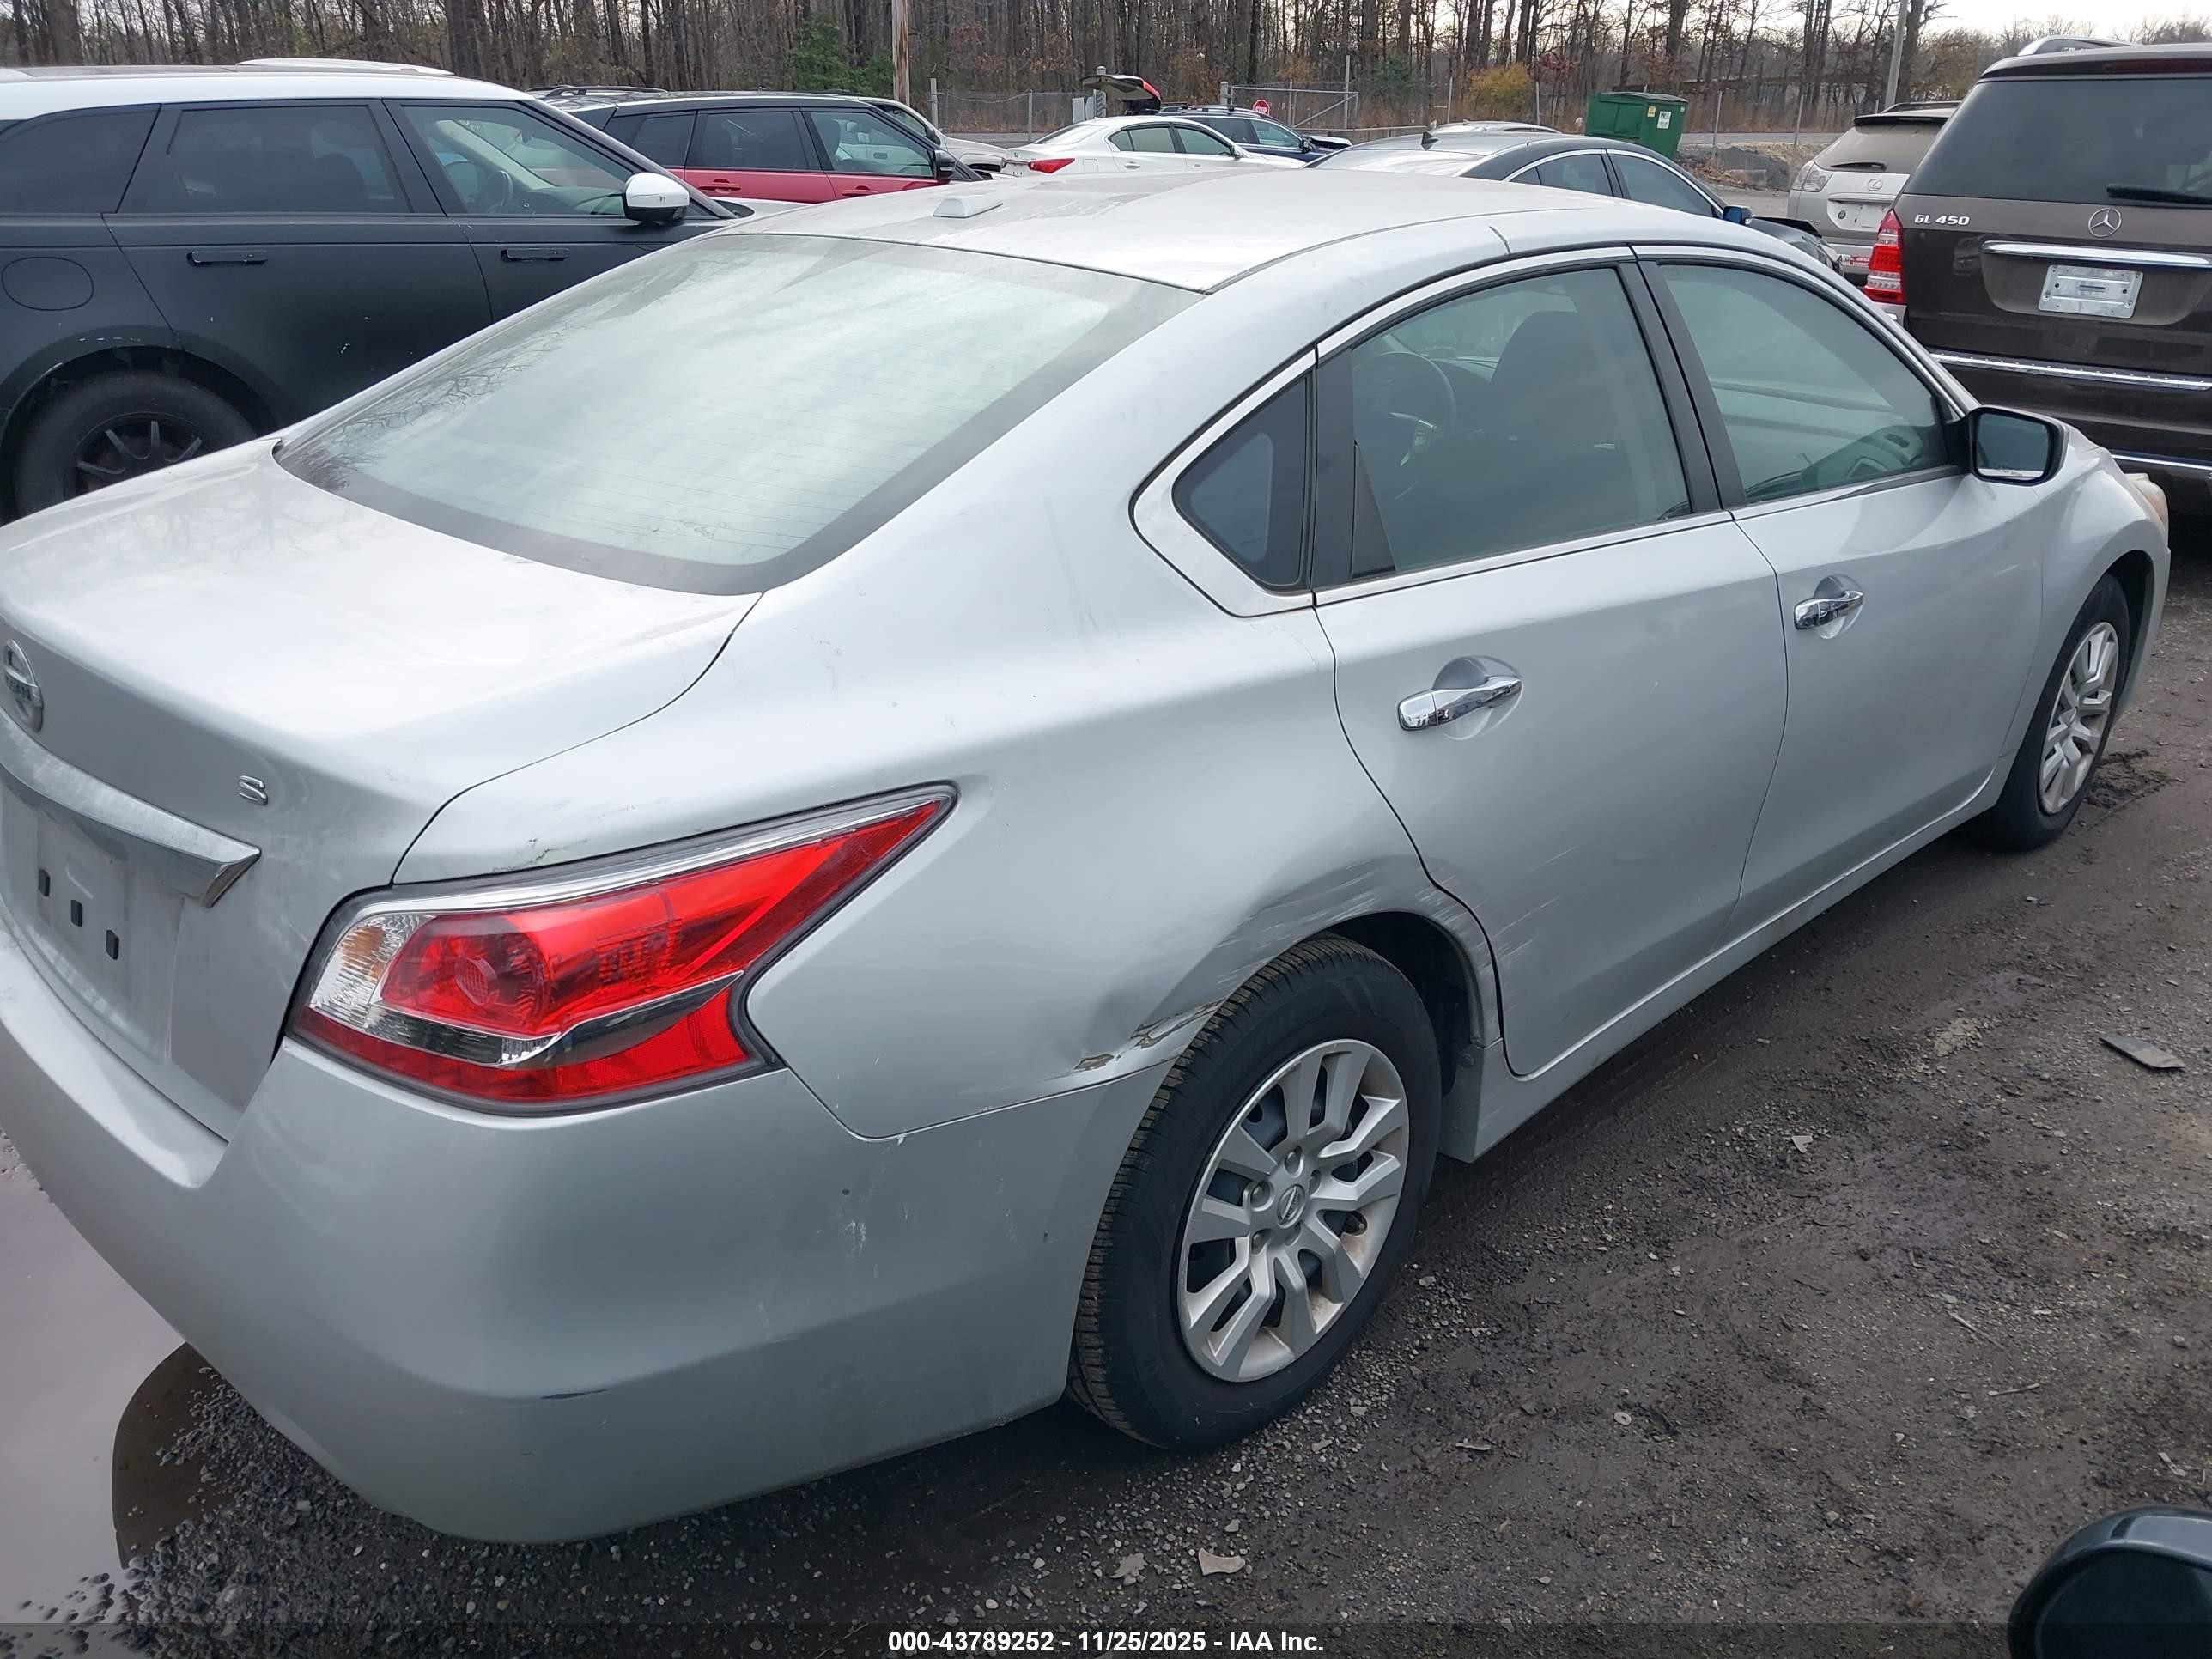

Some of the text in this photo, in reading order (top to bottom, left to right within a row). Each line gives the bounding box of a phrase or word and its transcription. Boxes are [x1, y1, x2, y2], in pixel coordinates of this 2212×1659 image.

[1914, 214, 1970, 225] GL 450
[239, 775, 269, 805] S
